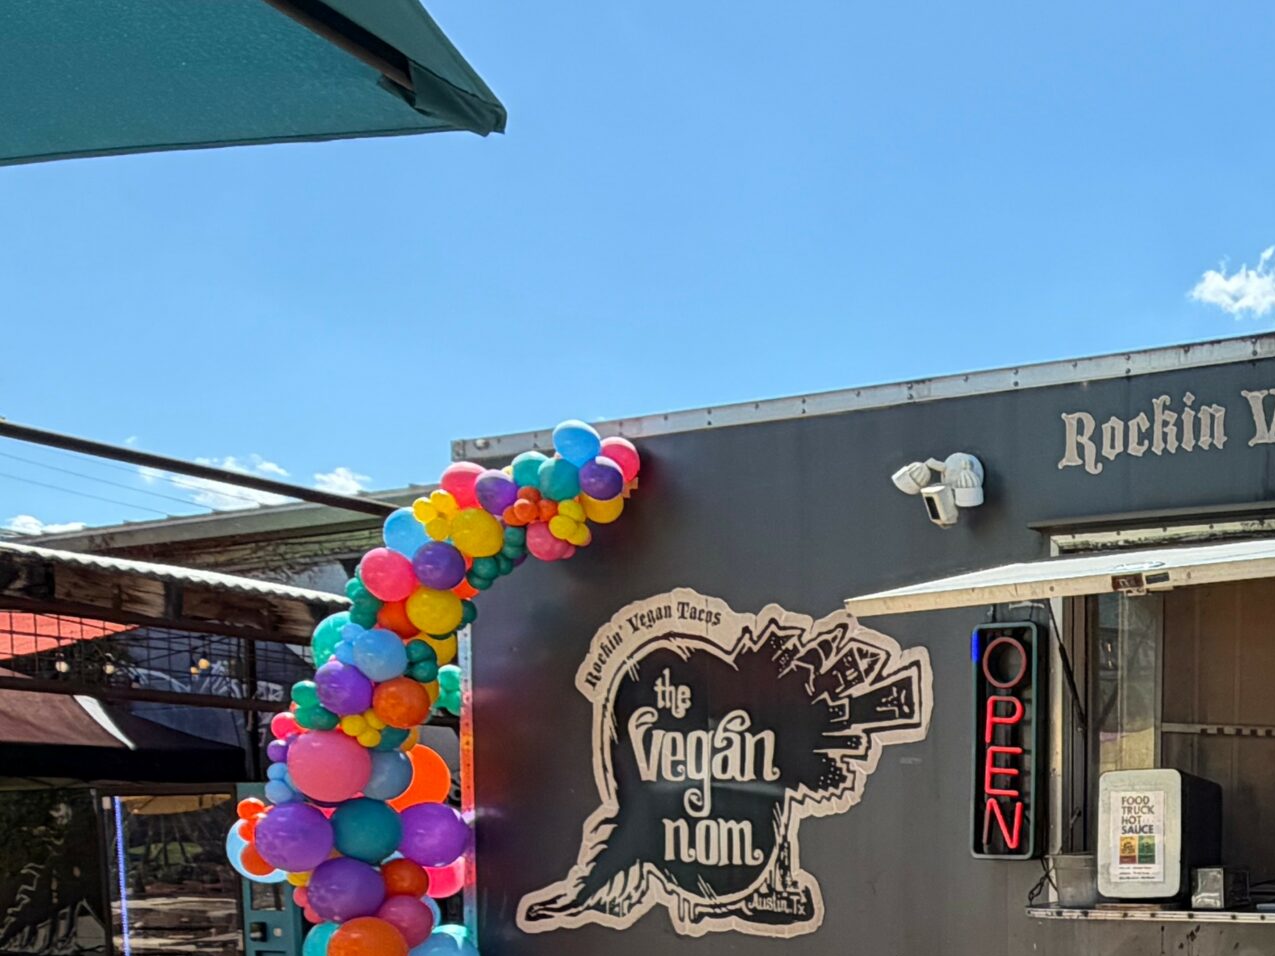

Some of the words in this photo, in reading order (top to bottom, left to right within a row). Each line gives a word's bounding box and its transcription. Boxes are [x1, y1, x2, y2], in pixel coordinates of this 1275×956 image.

[1058, 391, 1228, 475] Rockin
[626, 605, 673, 634] Vegan
[677, 602, 722, 627] Tacos
[654, 668, 692, 718] the
[982, 636, 1027, 850] OPEN
[1121, 796, 1150, 806] FOOD
[1121, 805, 1155, 815] TRUCK
[1121, 815, 1142, 825] HOT
[1121, 824, 1154, 835] SAUCE
[662, 818, 764, 866] nom
